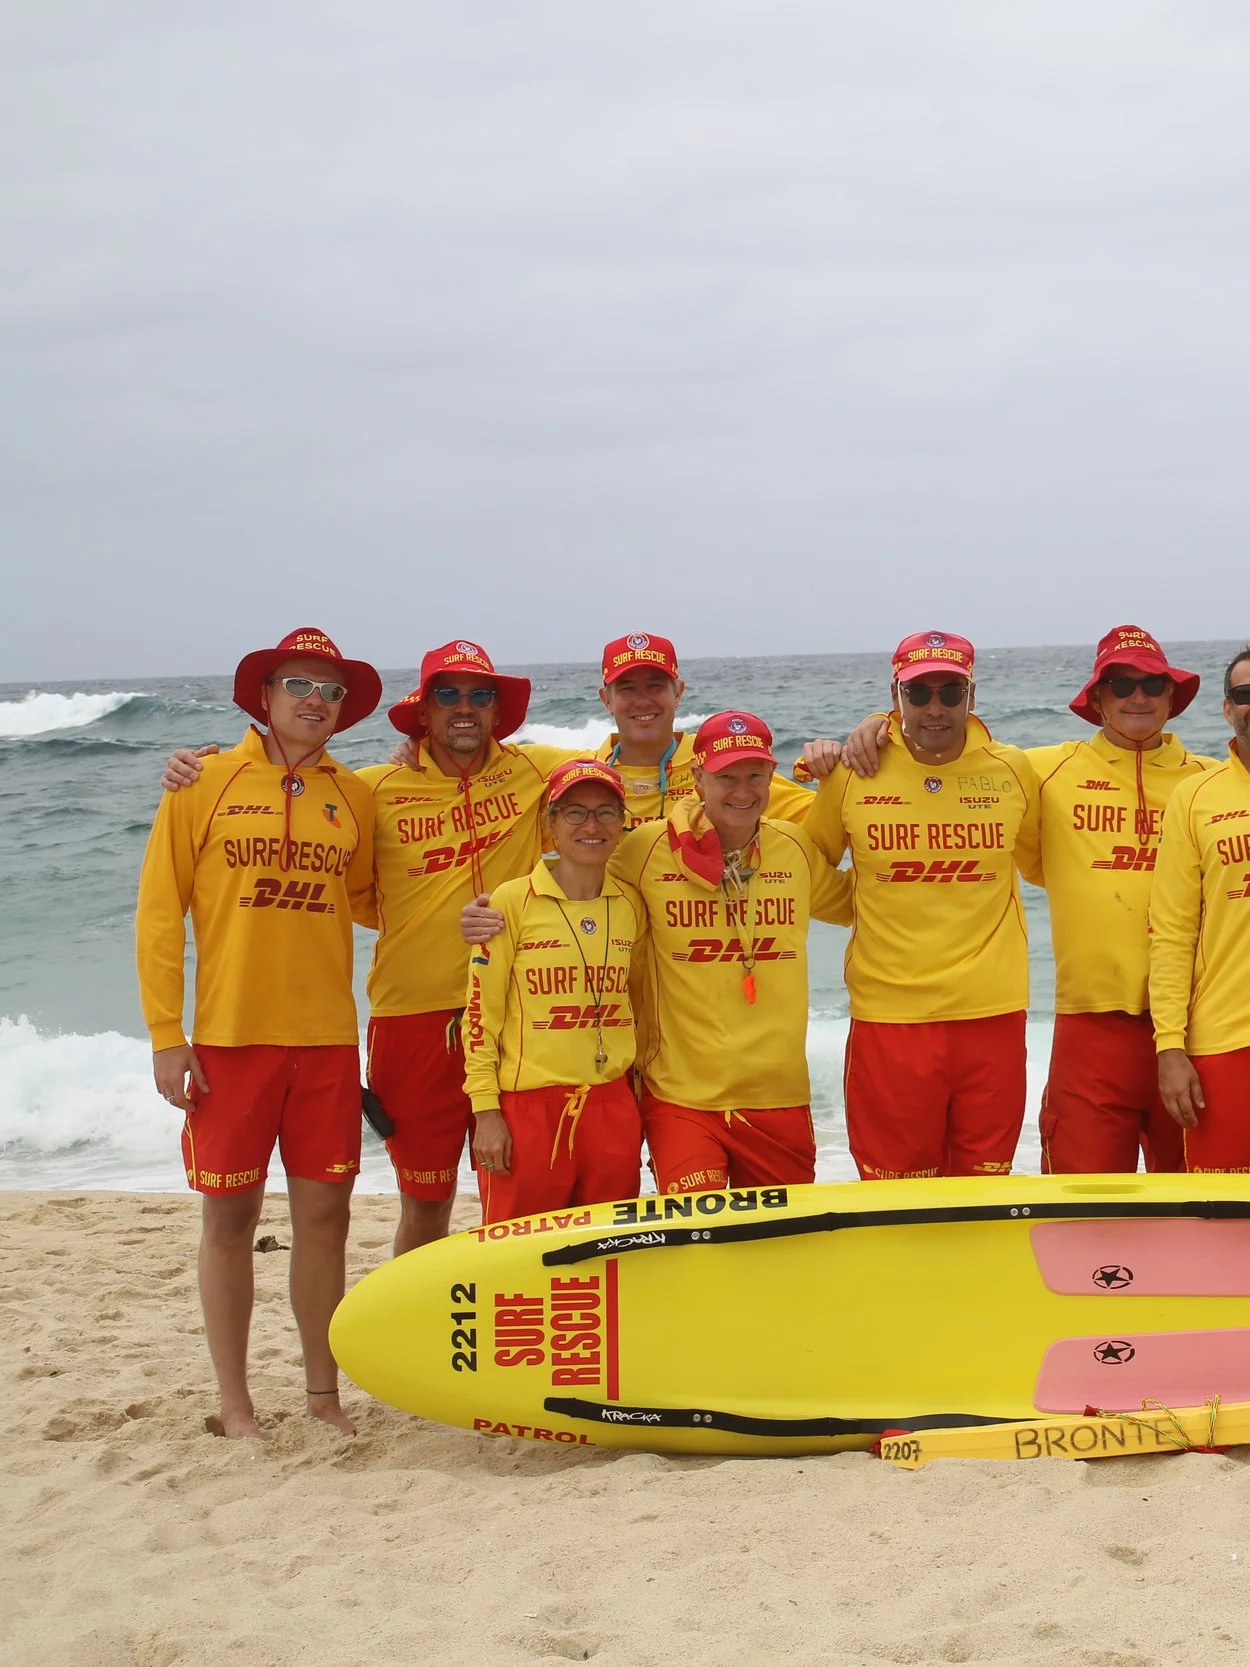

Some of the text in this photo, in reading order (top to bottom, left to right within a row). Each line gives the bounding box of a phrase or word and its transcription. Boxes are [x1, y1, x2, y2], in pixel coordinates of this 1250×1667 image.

[296, 633, 328, 643] SURF
[1118, 631, 1146, 640] SURF
[443, 653, 465, 665] SURF
[612, 649, 666, 668] SURF RESCUE
[907, 649, 964, 663] SURF RESCUE
[712, 734, 765, 752] SURF RESCUE
[477, 768, 513, 783] ISUZU
[484, 778, 506, 788] UTE
[561, 769, 581, 785] SURF
[957, 776, 1012, 794] PABLO
[1084, 779, 1113, 791] DHL
[392, 796, 435, 805] DHL
[863, 796, 904, 806] DHL
[959, 796, 1000, 804] ISUZU
[225, 804, 276, 817] DHL
[397, 792, 523, 845] SURF RESCUE
[1072, 804, 1128, 833] SURF
[1210, 809, 1250, 824] DHL
[867, 822, 1005, 851] SURF RESCUE
[223, 837, 281, 869] SURF
[1111, 845, 1158, 872] DH
[889, 860, 984, 883] DHL
[251, 877, 328, 914] DHL
[665, 897, 796, 929] SURF RESCUE
[521, 939, 564, 951] DHL
[611, 938, 633, 947] ISUZ
[687, 937, 782, 963] DHL
[525, 966, 578, 996] SURF
[548, 1004, 623, 1030] DHL
[200, 1167, 261, 1188] SURF RESCUE
[413, 1167, 457, 1184] SURF RES
[679, 1170, 706, 1190] SURF
[612, 1187, 789, 1226] BRONTE
[476, 1210, 593, 1244] PATROL
[596, 1230, 667, 1251] KRACKA
[450, 1282, 478, 1373] 2212
[493, 1292, 546, 1368] SURF
[550, 1275, 602, 1387] RESCUE
[601, 1408, 663, 1423] KRACKA
[472, 1417, 598, 1446] PATROL
[1014, 1417, 1176, 1461] BRONTE
[882, 1439, 922, 1463] 2207
